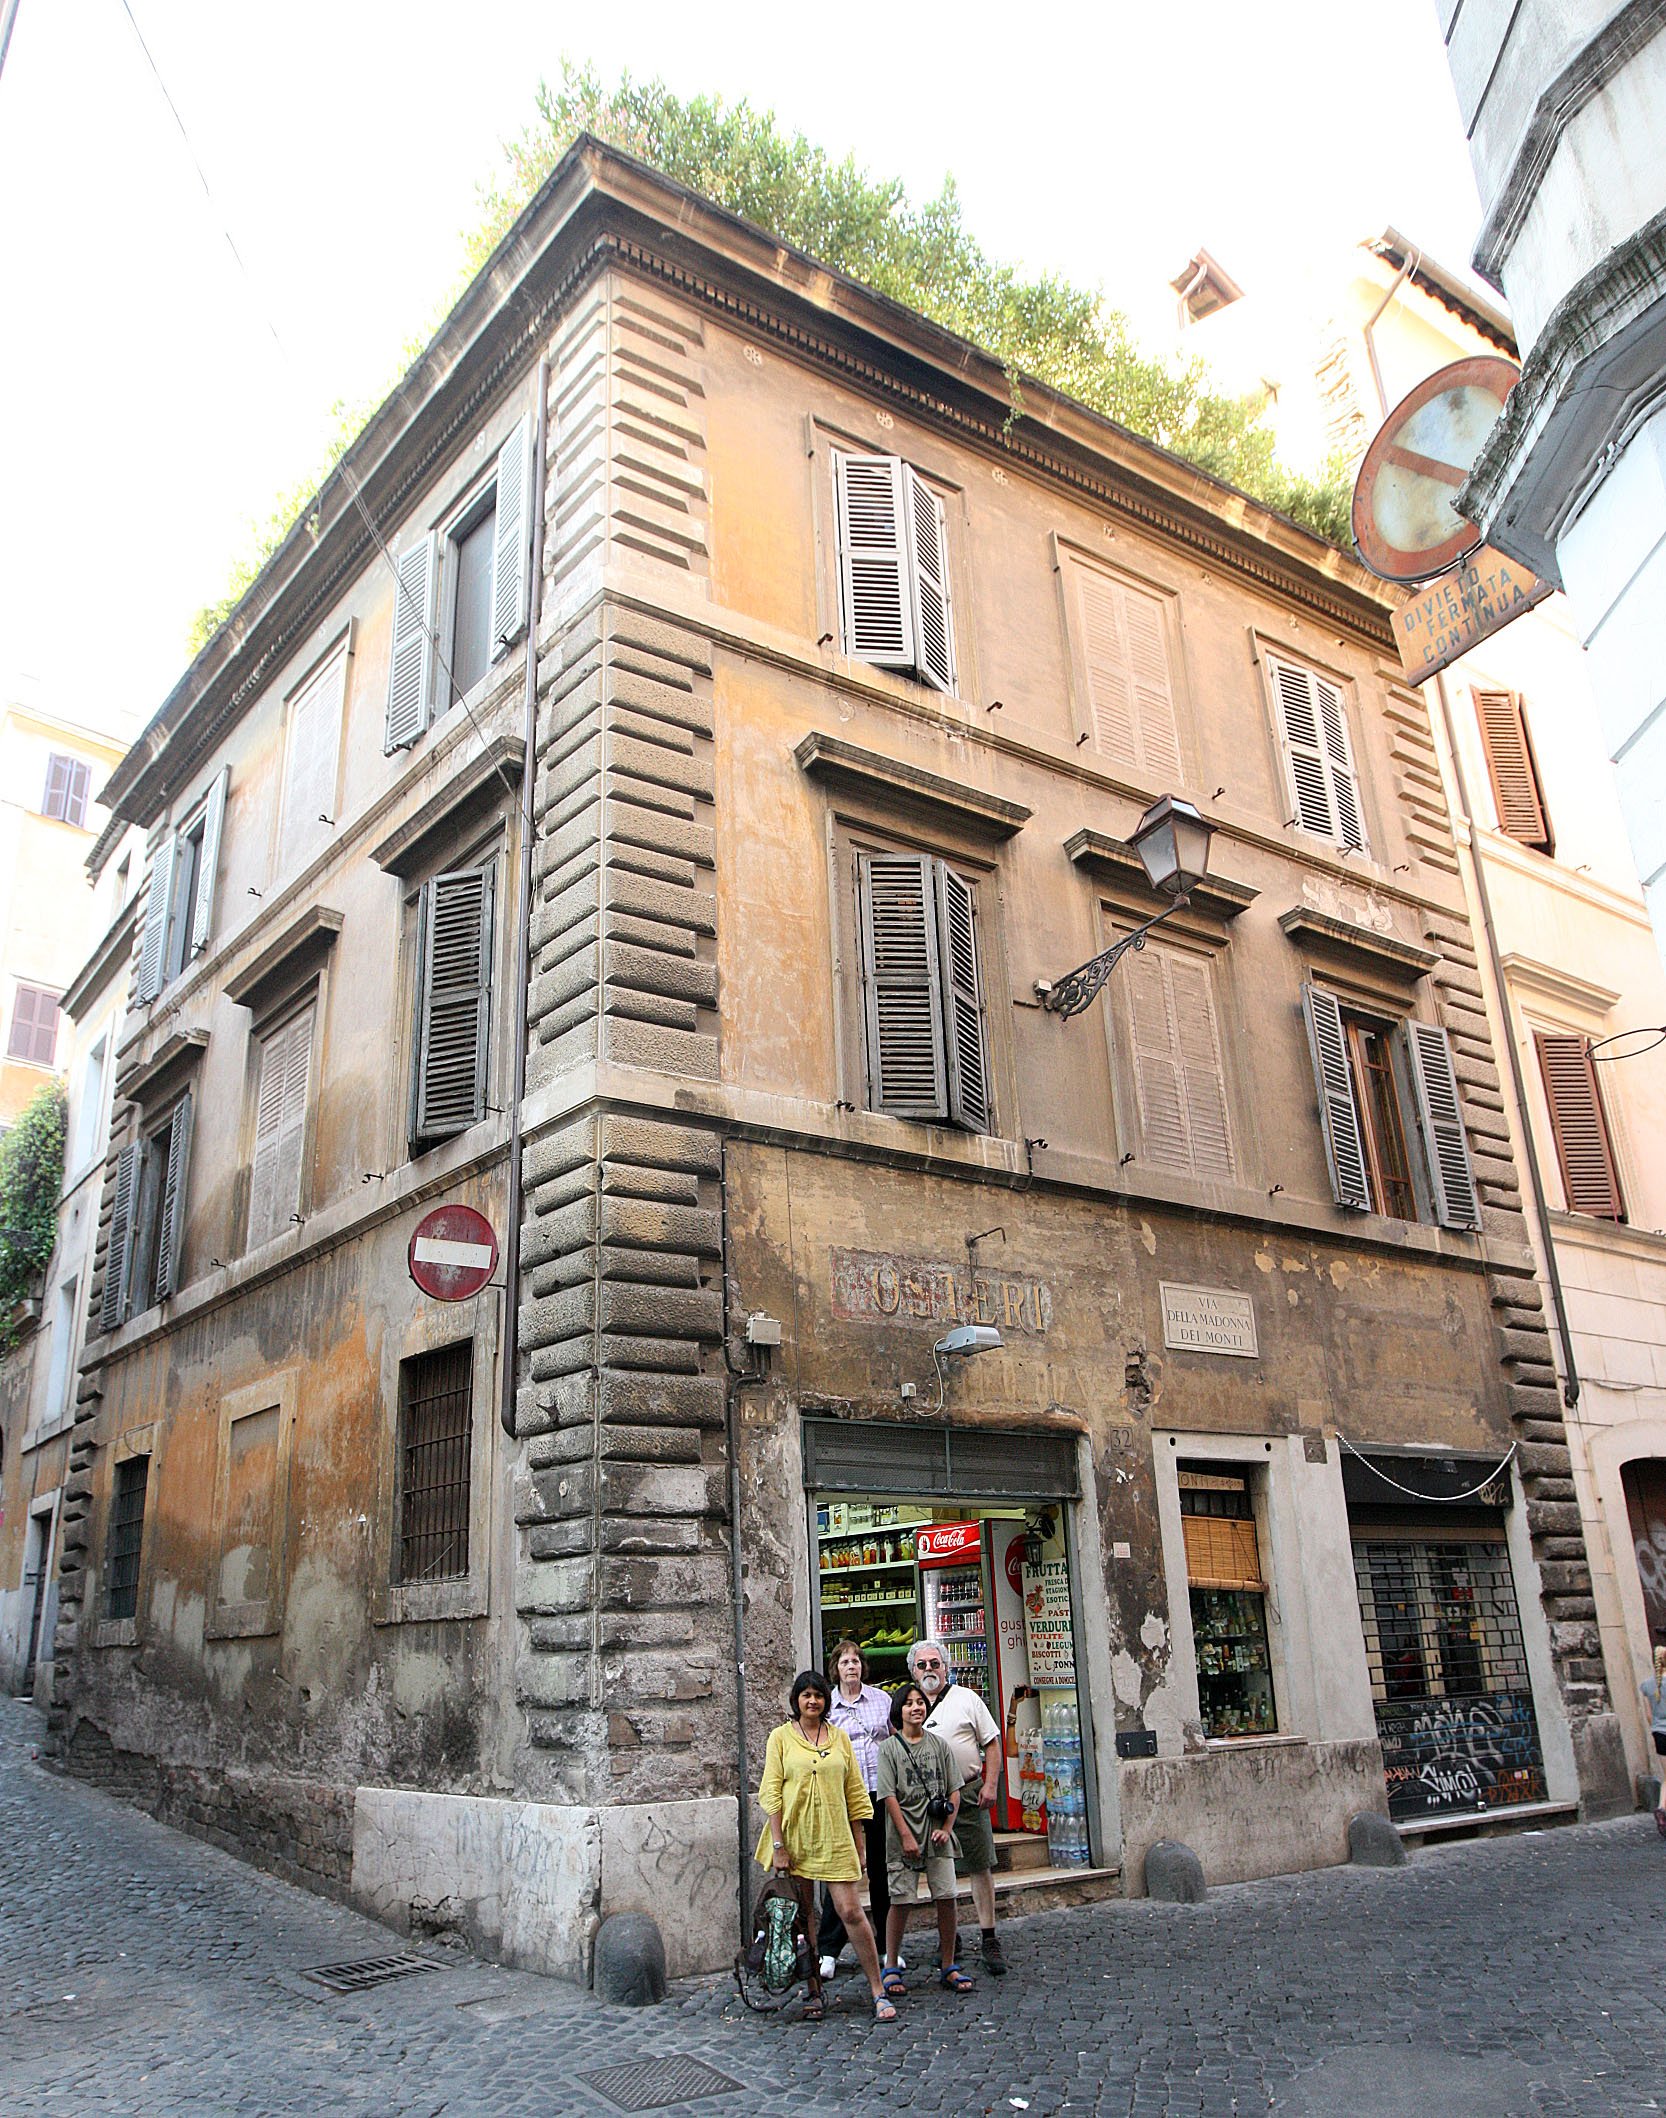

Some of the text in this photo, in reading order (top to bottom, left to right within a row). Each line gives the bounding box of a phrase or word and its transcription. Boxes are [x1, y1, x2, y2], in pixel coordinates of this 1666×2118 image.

[1404, 567, 1480, 632] DIVIETO
[1426, 567, 1512, 637] FERMATA
[1422, 584, 1526, 664] CONTINUA
[1198, 1297, 1218, 1310] VIA
[1167, 1309, 1251, 1331] DELLA MADONNA
[1180, 1328, 1243, 1347] DEI MONTI
[1111, 1429, 1132, 1448] 32
[1045, 1586, 1069, 1595] STAGION
[1046, 1595, 1069, 1604] ESOTIC
[1048, 1609, 1070, 1617] PAST
[1001, 1618, 1026, 1633] gust
[1007, 1633, 1027, 1650] ghi
[1031, 1650, 1061, 1659] BISCOTTI
[1054, 1660, 1074, 1669] TONN
